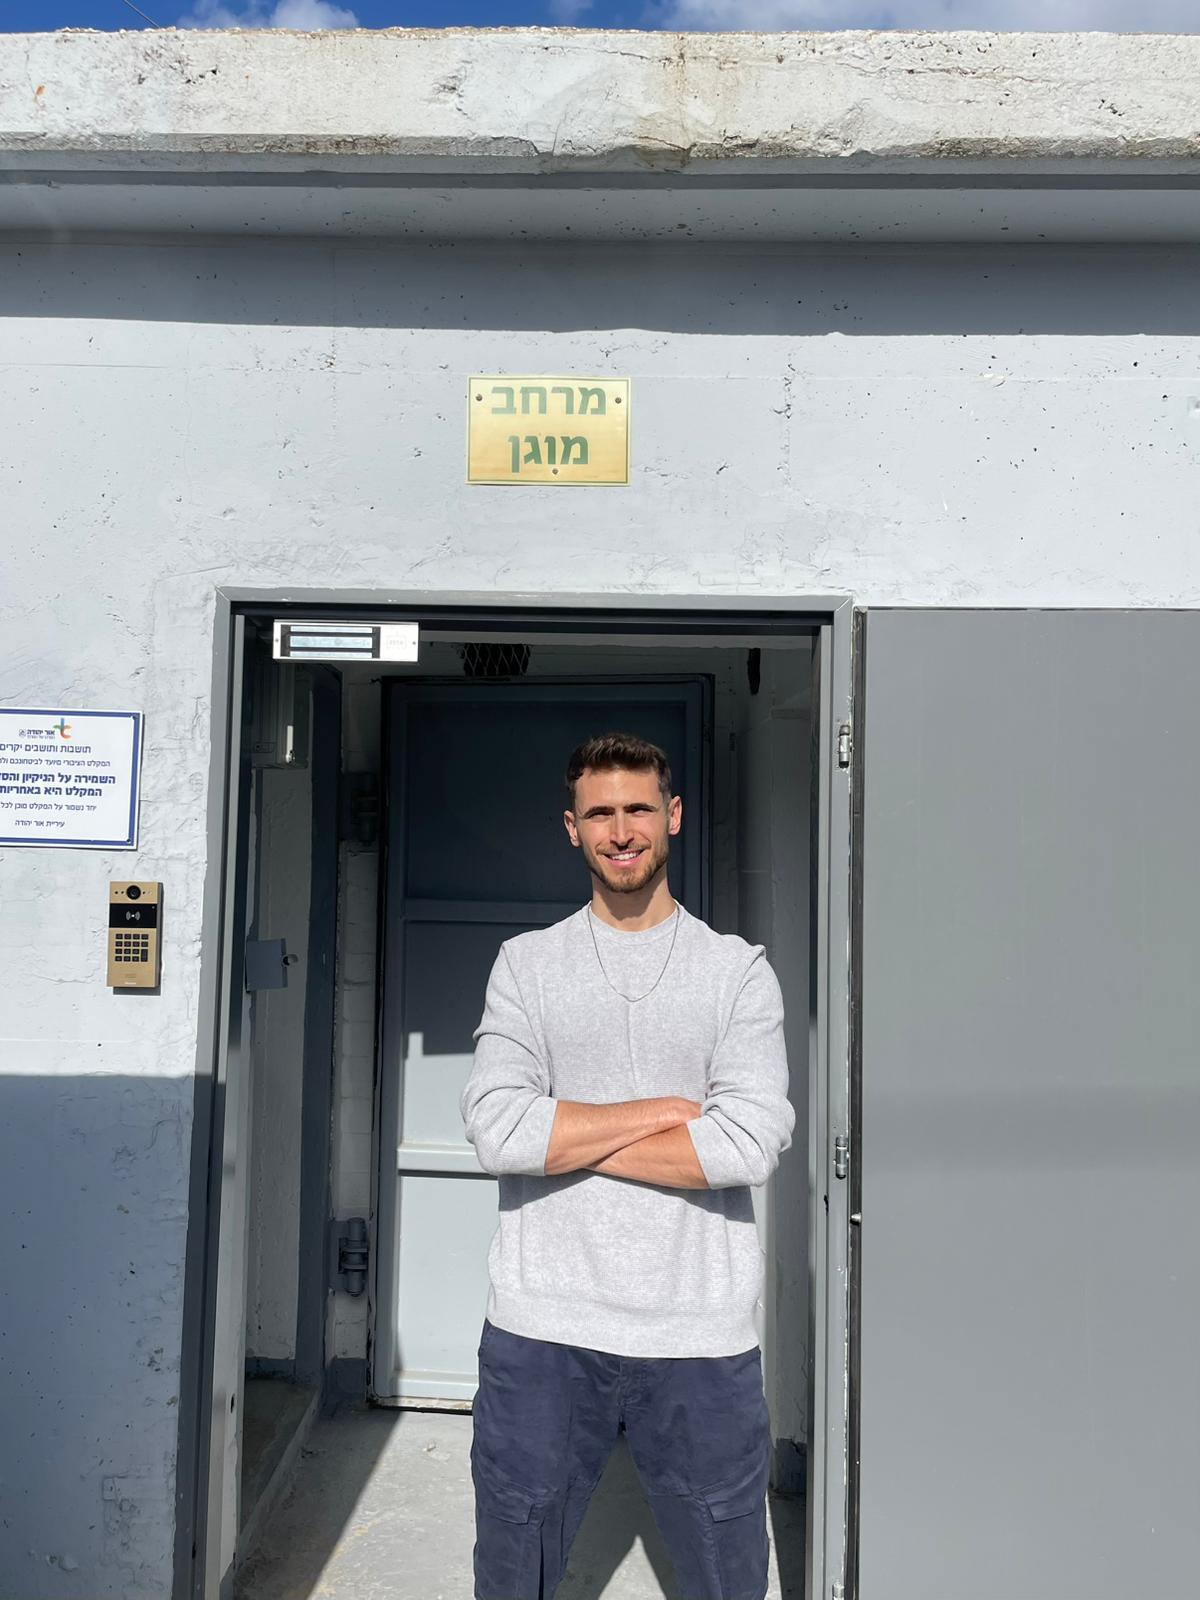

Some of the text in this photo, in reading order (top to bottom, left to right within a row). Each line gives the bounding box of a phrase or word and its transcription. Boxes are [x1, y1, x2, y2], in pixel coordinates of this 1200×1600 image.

[491, 386, 606, 415] מרחב
[508, 435, 588, 473] מוגן
[0, 743, 91, 753] תושבות ותושבים יקרים
[87, 759, 111, 768] המקלט
[22, 773, 55, 783] הניקיון
[58, 772, 72, 784] על
[74, 775, 116, 784] השמירה
[43, 786, 62, 795] היא
[65, 786, 102, 797] המקלט
[0, 801, 13, 809] לכל
[29, 802, 53, 810] המקלט
[54, 803, 63, 811] על
[14, 819, 33, 827] יהודה
[46, 820, 65, 828] עיריית
